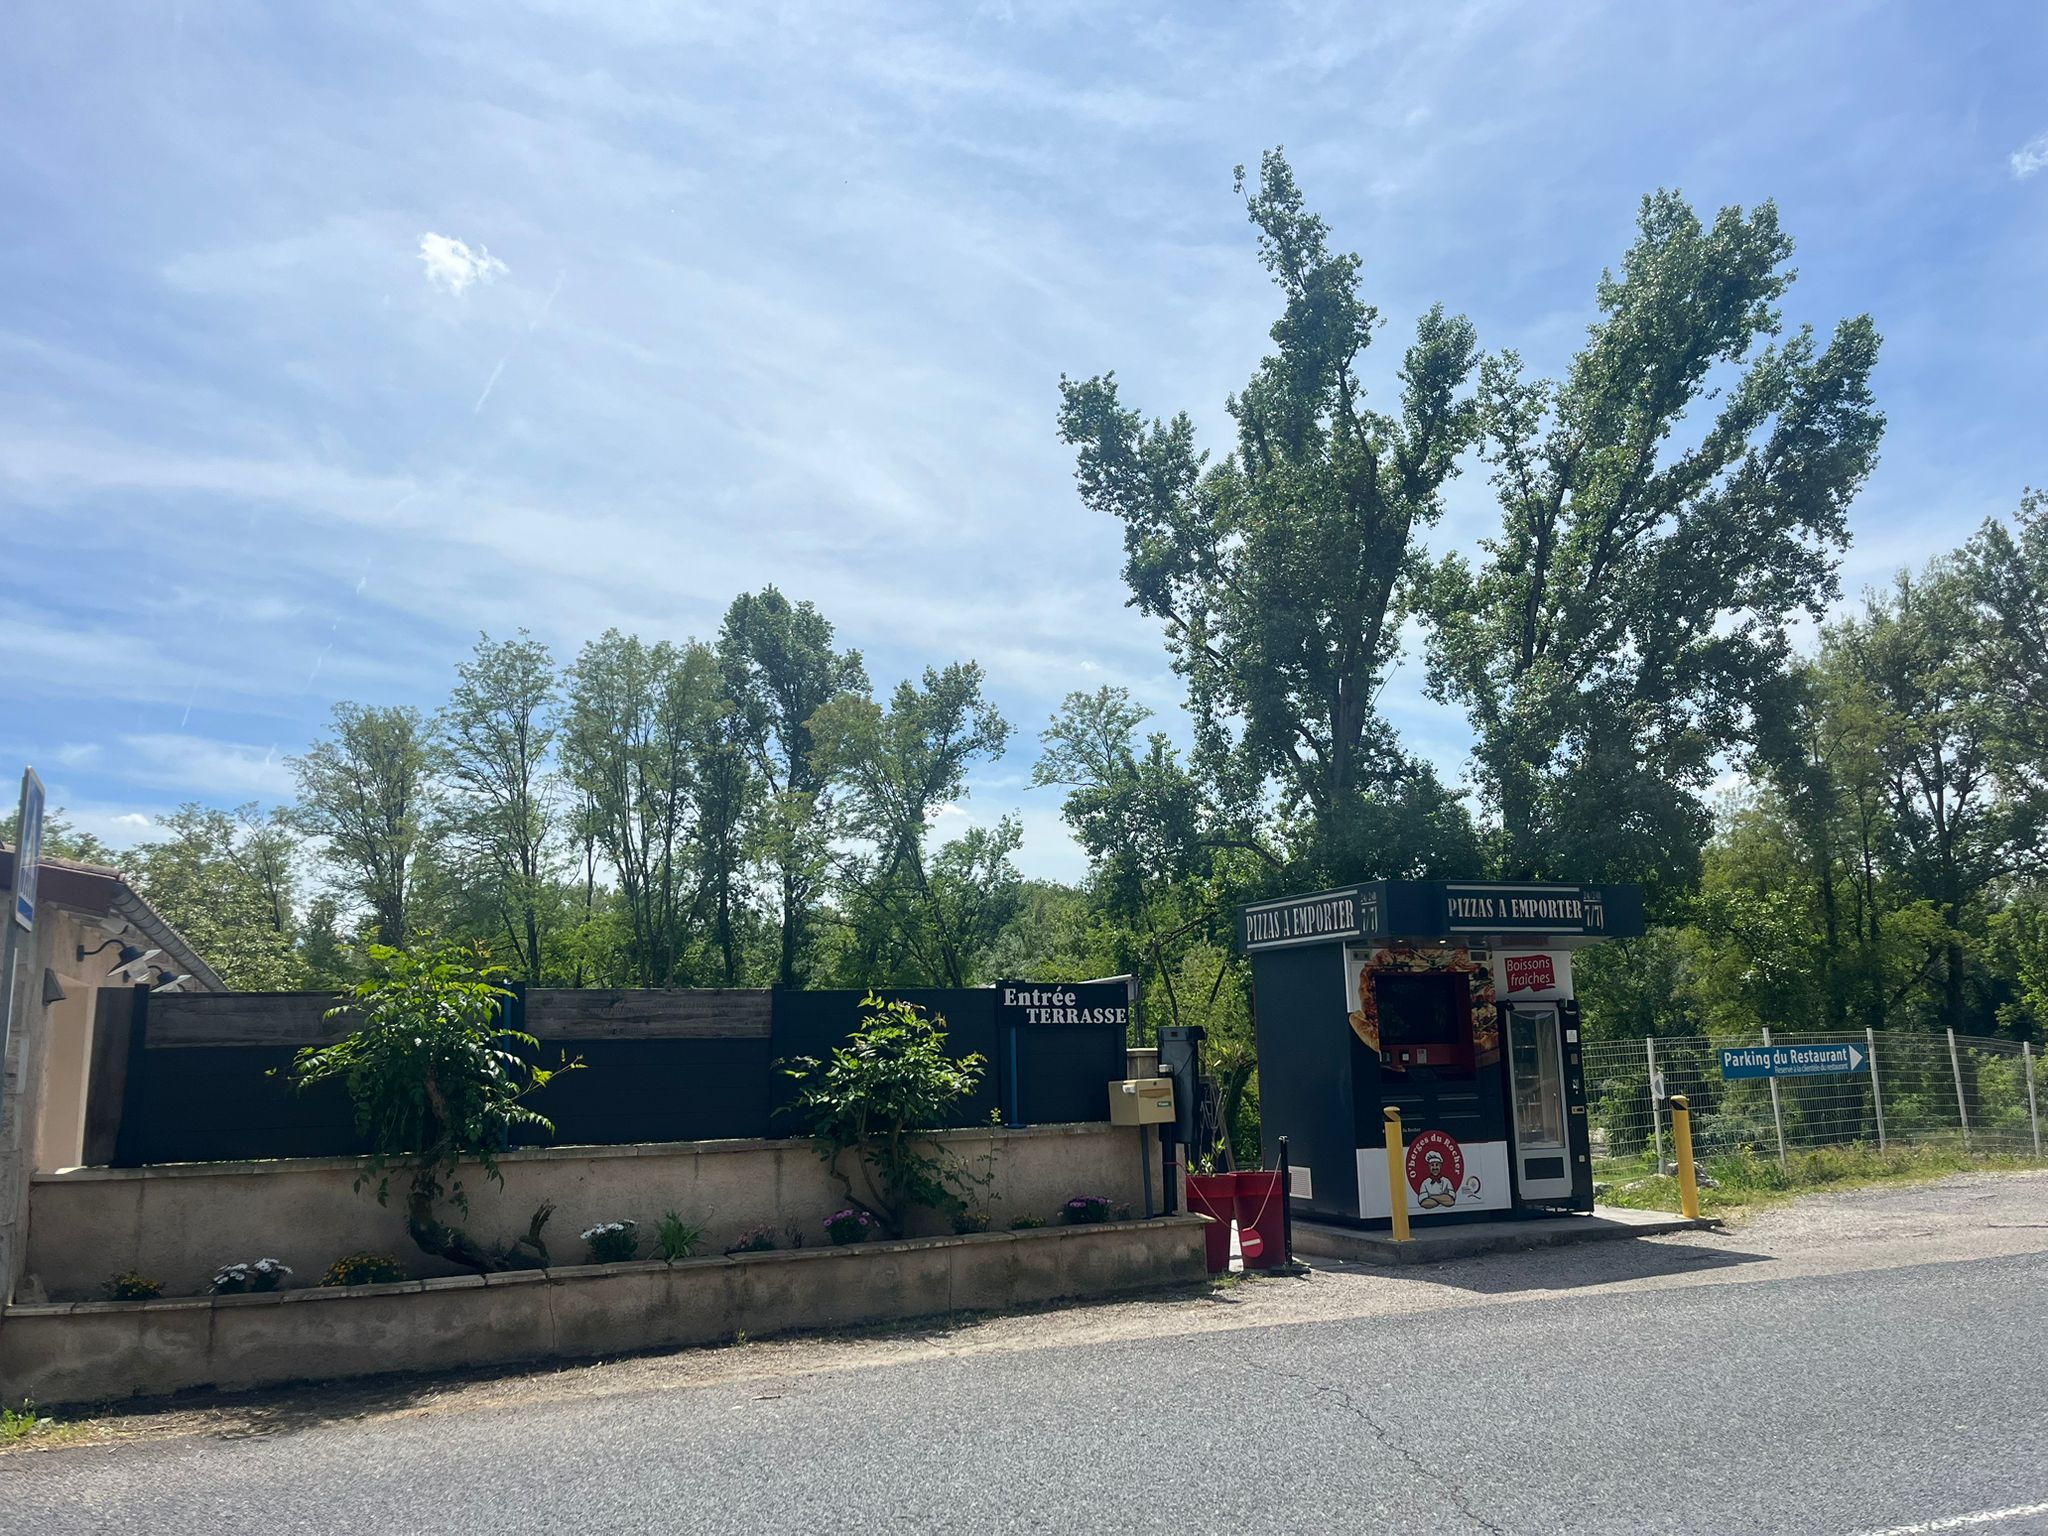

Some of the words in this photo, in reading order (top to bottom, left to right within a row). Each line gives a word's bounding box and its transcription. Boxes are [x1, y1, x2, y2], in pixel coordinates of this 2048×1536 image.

[1448, 898, 1493, 918] PIZZAS
[1499, 898, 1508, 918] A
[1511, 898, 1583, 919] EMPORTER
[1246, 910, 1280, 942] PIZZAS
[1283, 909, 1290, 937] A
[1293, 899, 1354, 936] EMPORTER
[1507, 959, 1550, 971] Boissons
[1004, 985, 1076, 1006] Entrée
[1026, 1007, 1127, 1024] TERRASSE
[1724, 1051, 1770, 1069] Parking
[1773, 1050, 1788, 1065] du
[1790, 1048, 1848, 1064] Restaurant
[1431, 1134, 1442, 1142] du
[1444, 1139, 1460, 1175] Rocher
